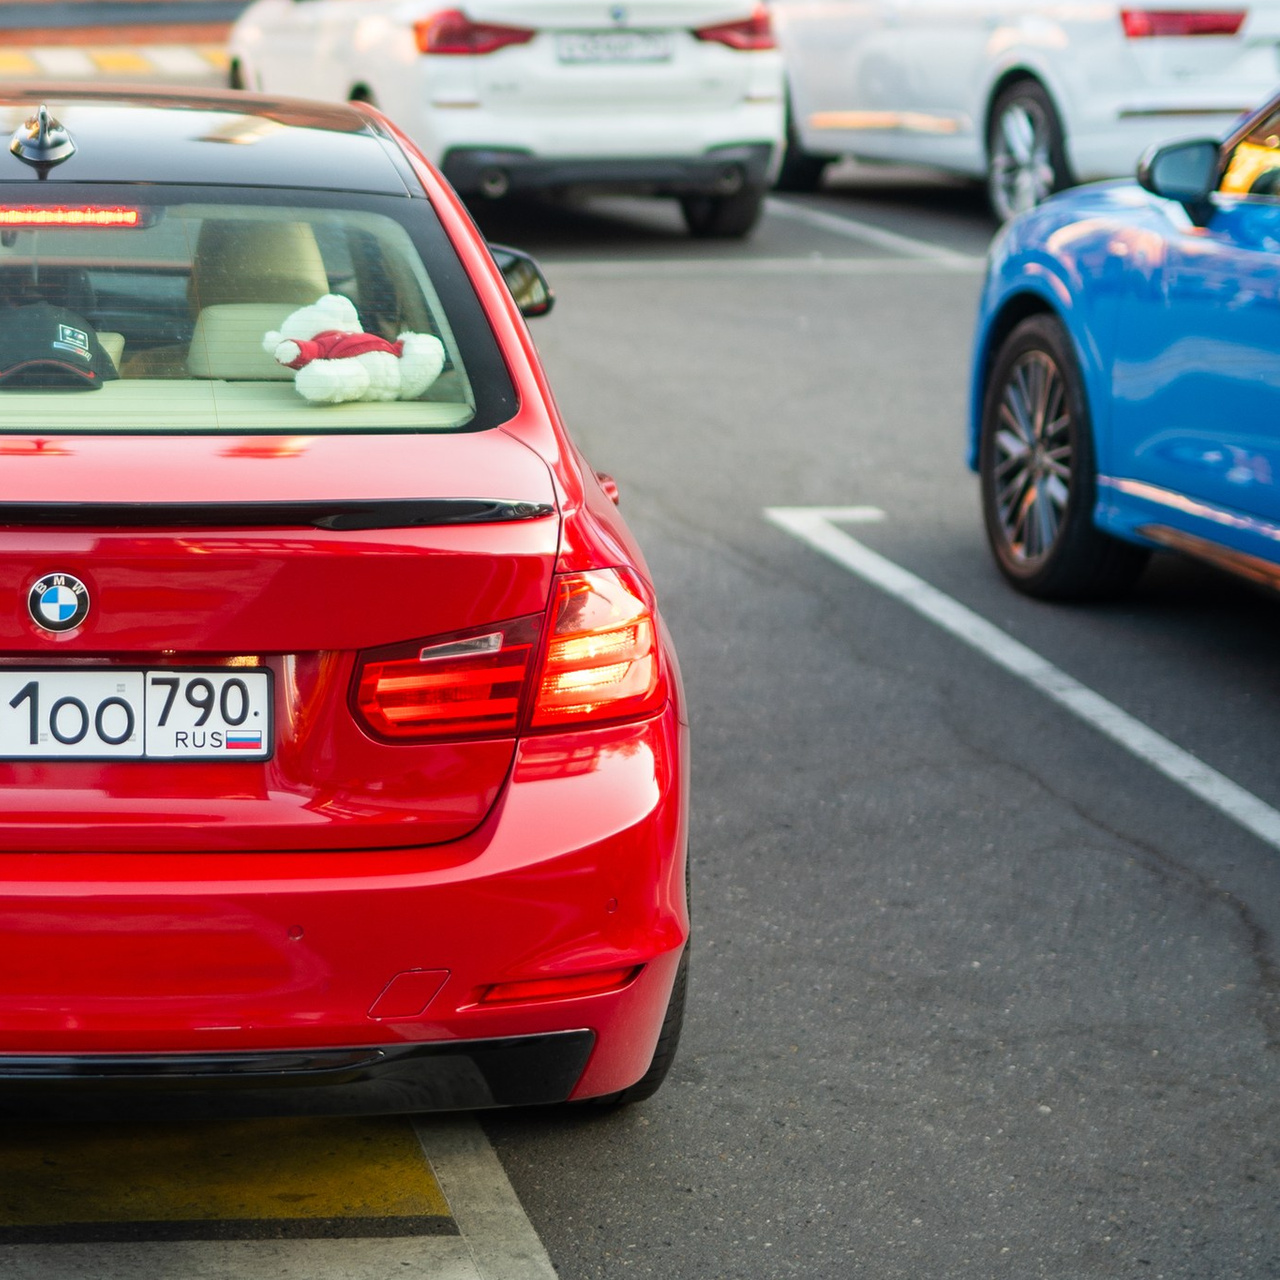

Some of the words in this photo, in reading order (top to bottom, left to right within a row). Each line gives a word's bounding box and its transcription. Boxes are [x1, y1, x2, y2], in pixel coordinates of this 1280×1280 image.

[34, 575, 85, 595] BMW
[150, 677, 250, 727] 790
[174, 731, 224, 749] RUS
